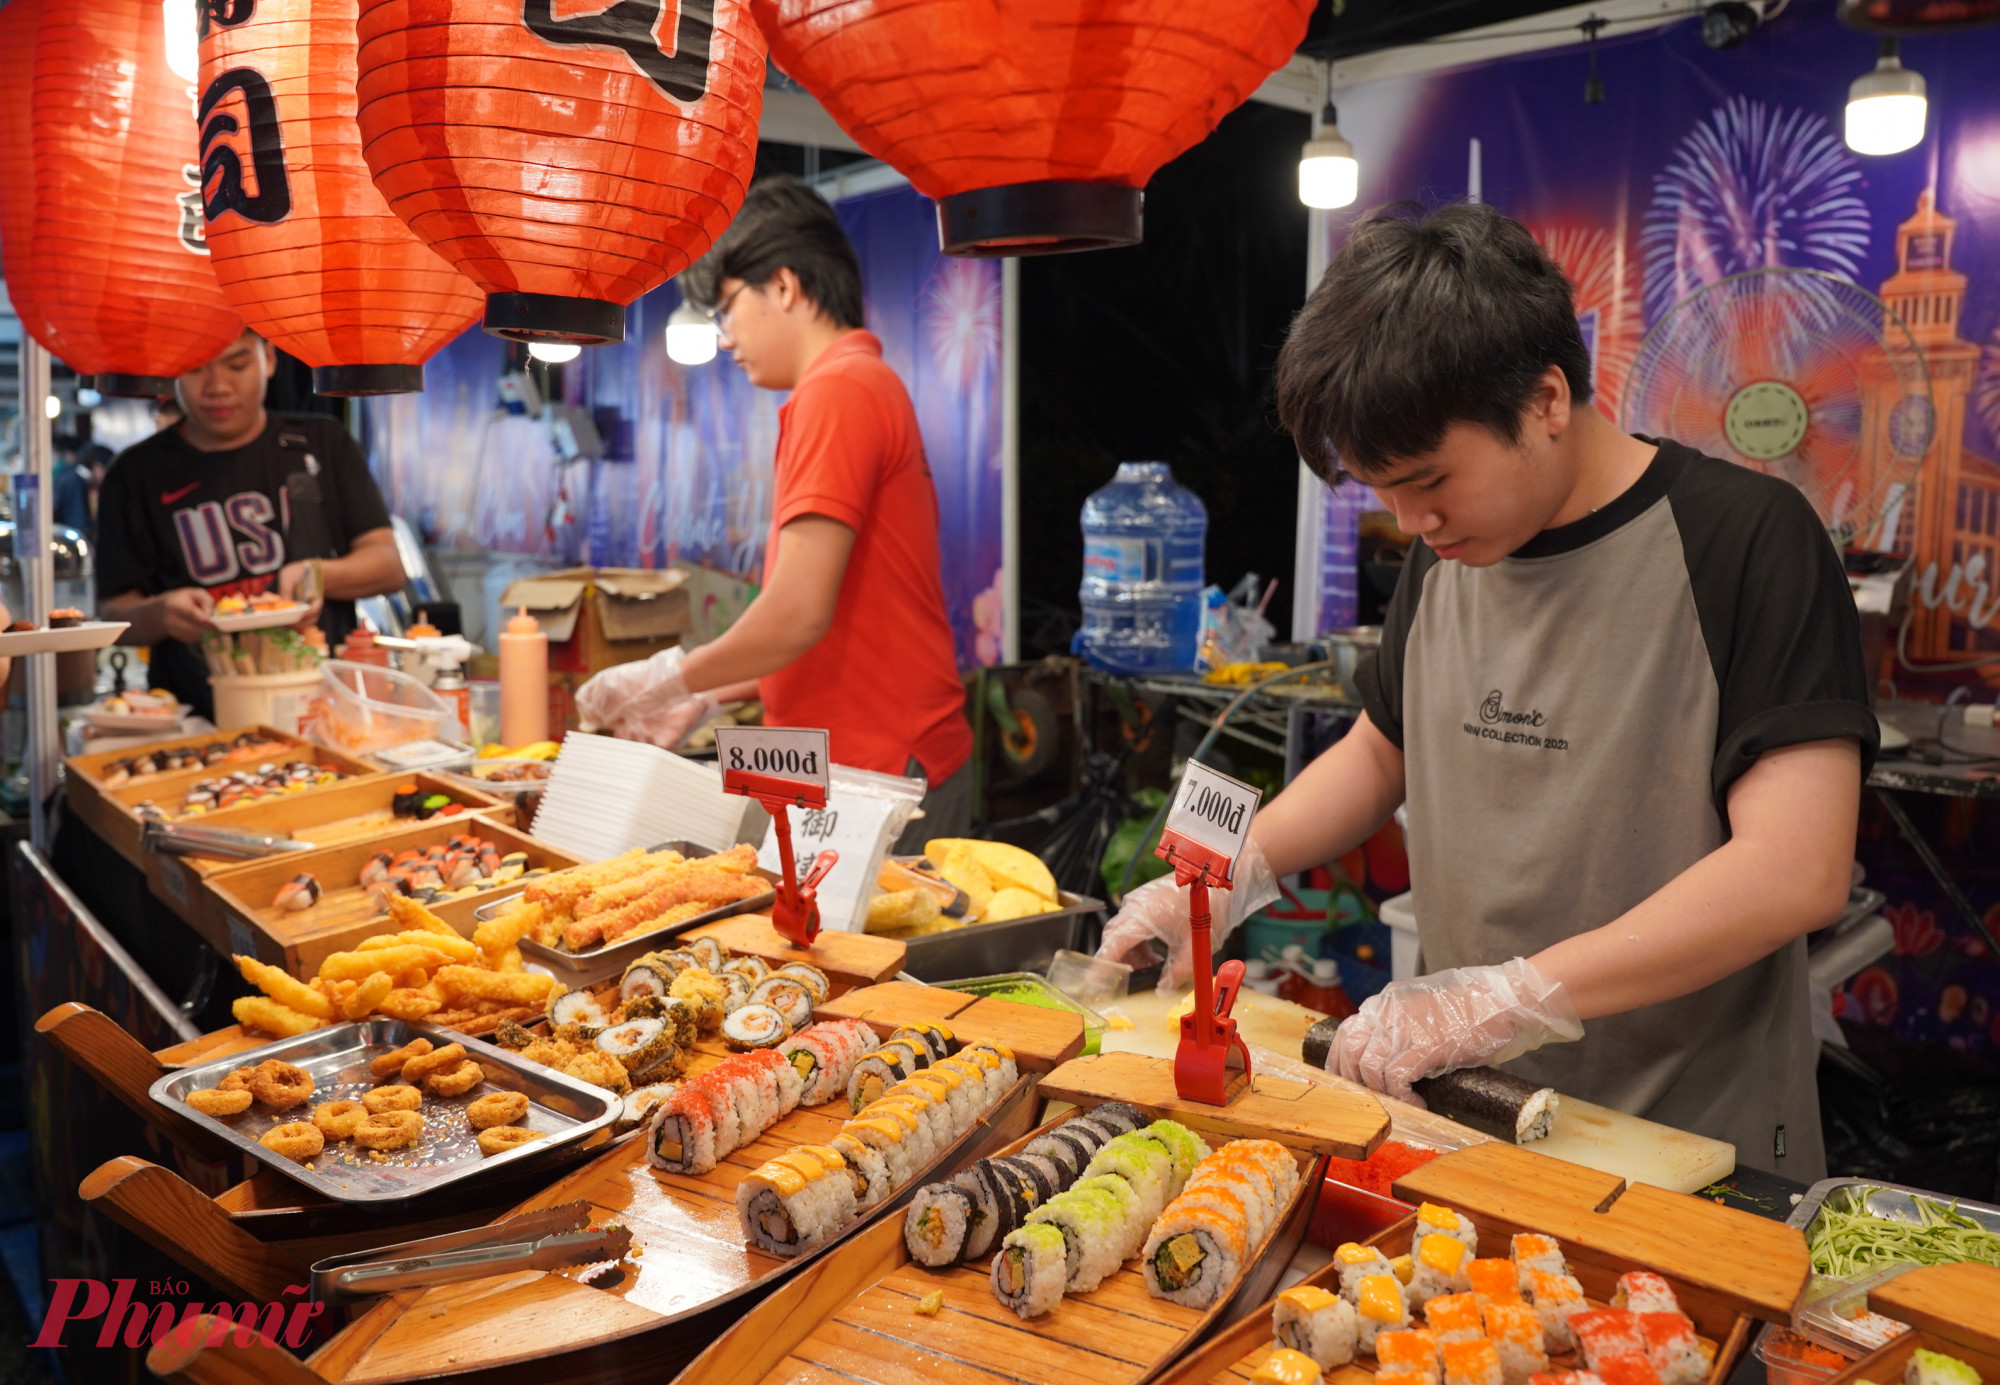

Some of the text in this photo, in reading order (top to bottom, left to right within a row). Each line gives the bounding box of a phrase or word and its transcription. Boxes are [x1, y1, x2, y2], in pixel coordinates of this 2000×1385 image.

[172, 485, 291, 586] US
[729, 746, 818, 775] 8.000đ
[1481, 727, 1541, 748] COLLECTION
[1543, 737, 1569, 751] 2023
[1183, 778, 1246, 835] 7.000đ
